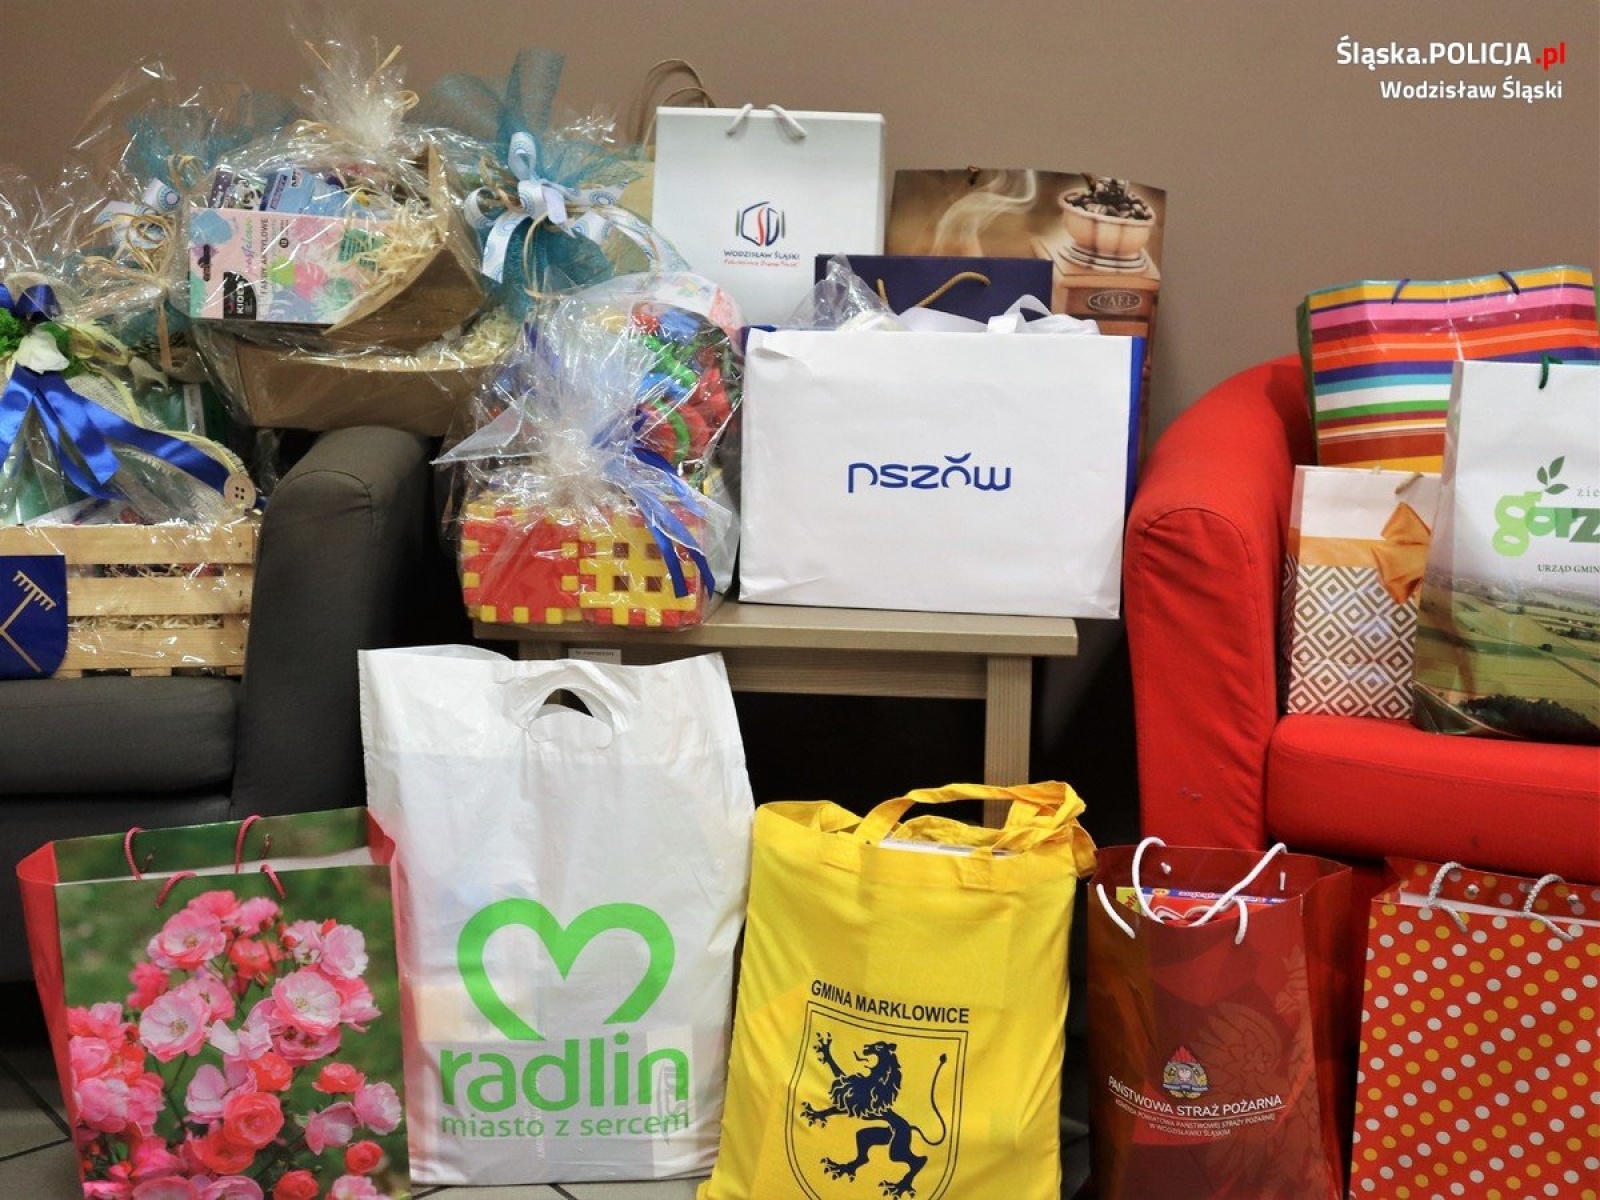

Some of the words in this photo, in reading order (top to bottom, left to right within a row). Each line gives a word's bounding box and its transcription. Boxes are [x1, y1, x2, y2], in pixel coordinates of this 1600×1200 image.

[723, 249, 772, 259] WODZISŁAW
[1537, 564, 1572, 575] URZĄD
[811, 979, 852, 1008] GMINA
[855, 994, 970, 1024] MARKLOWICE
[439, 1031, 689, 1113] radlin
[1108, 1075, 1174, 1115] PAŃSTWOWA
[1177, 1104, 1220, 1117] STRAŻ
[1223, 1094, 1283, 1115] POŻARNA
[441, 1113, 545, 1137] miasto
[555, 1119, 570, 1137] z
[580, 1110, 689, 1138] sercem
